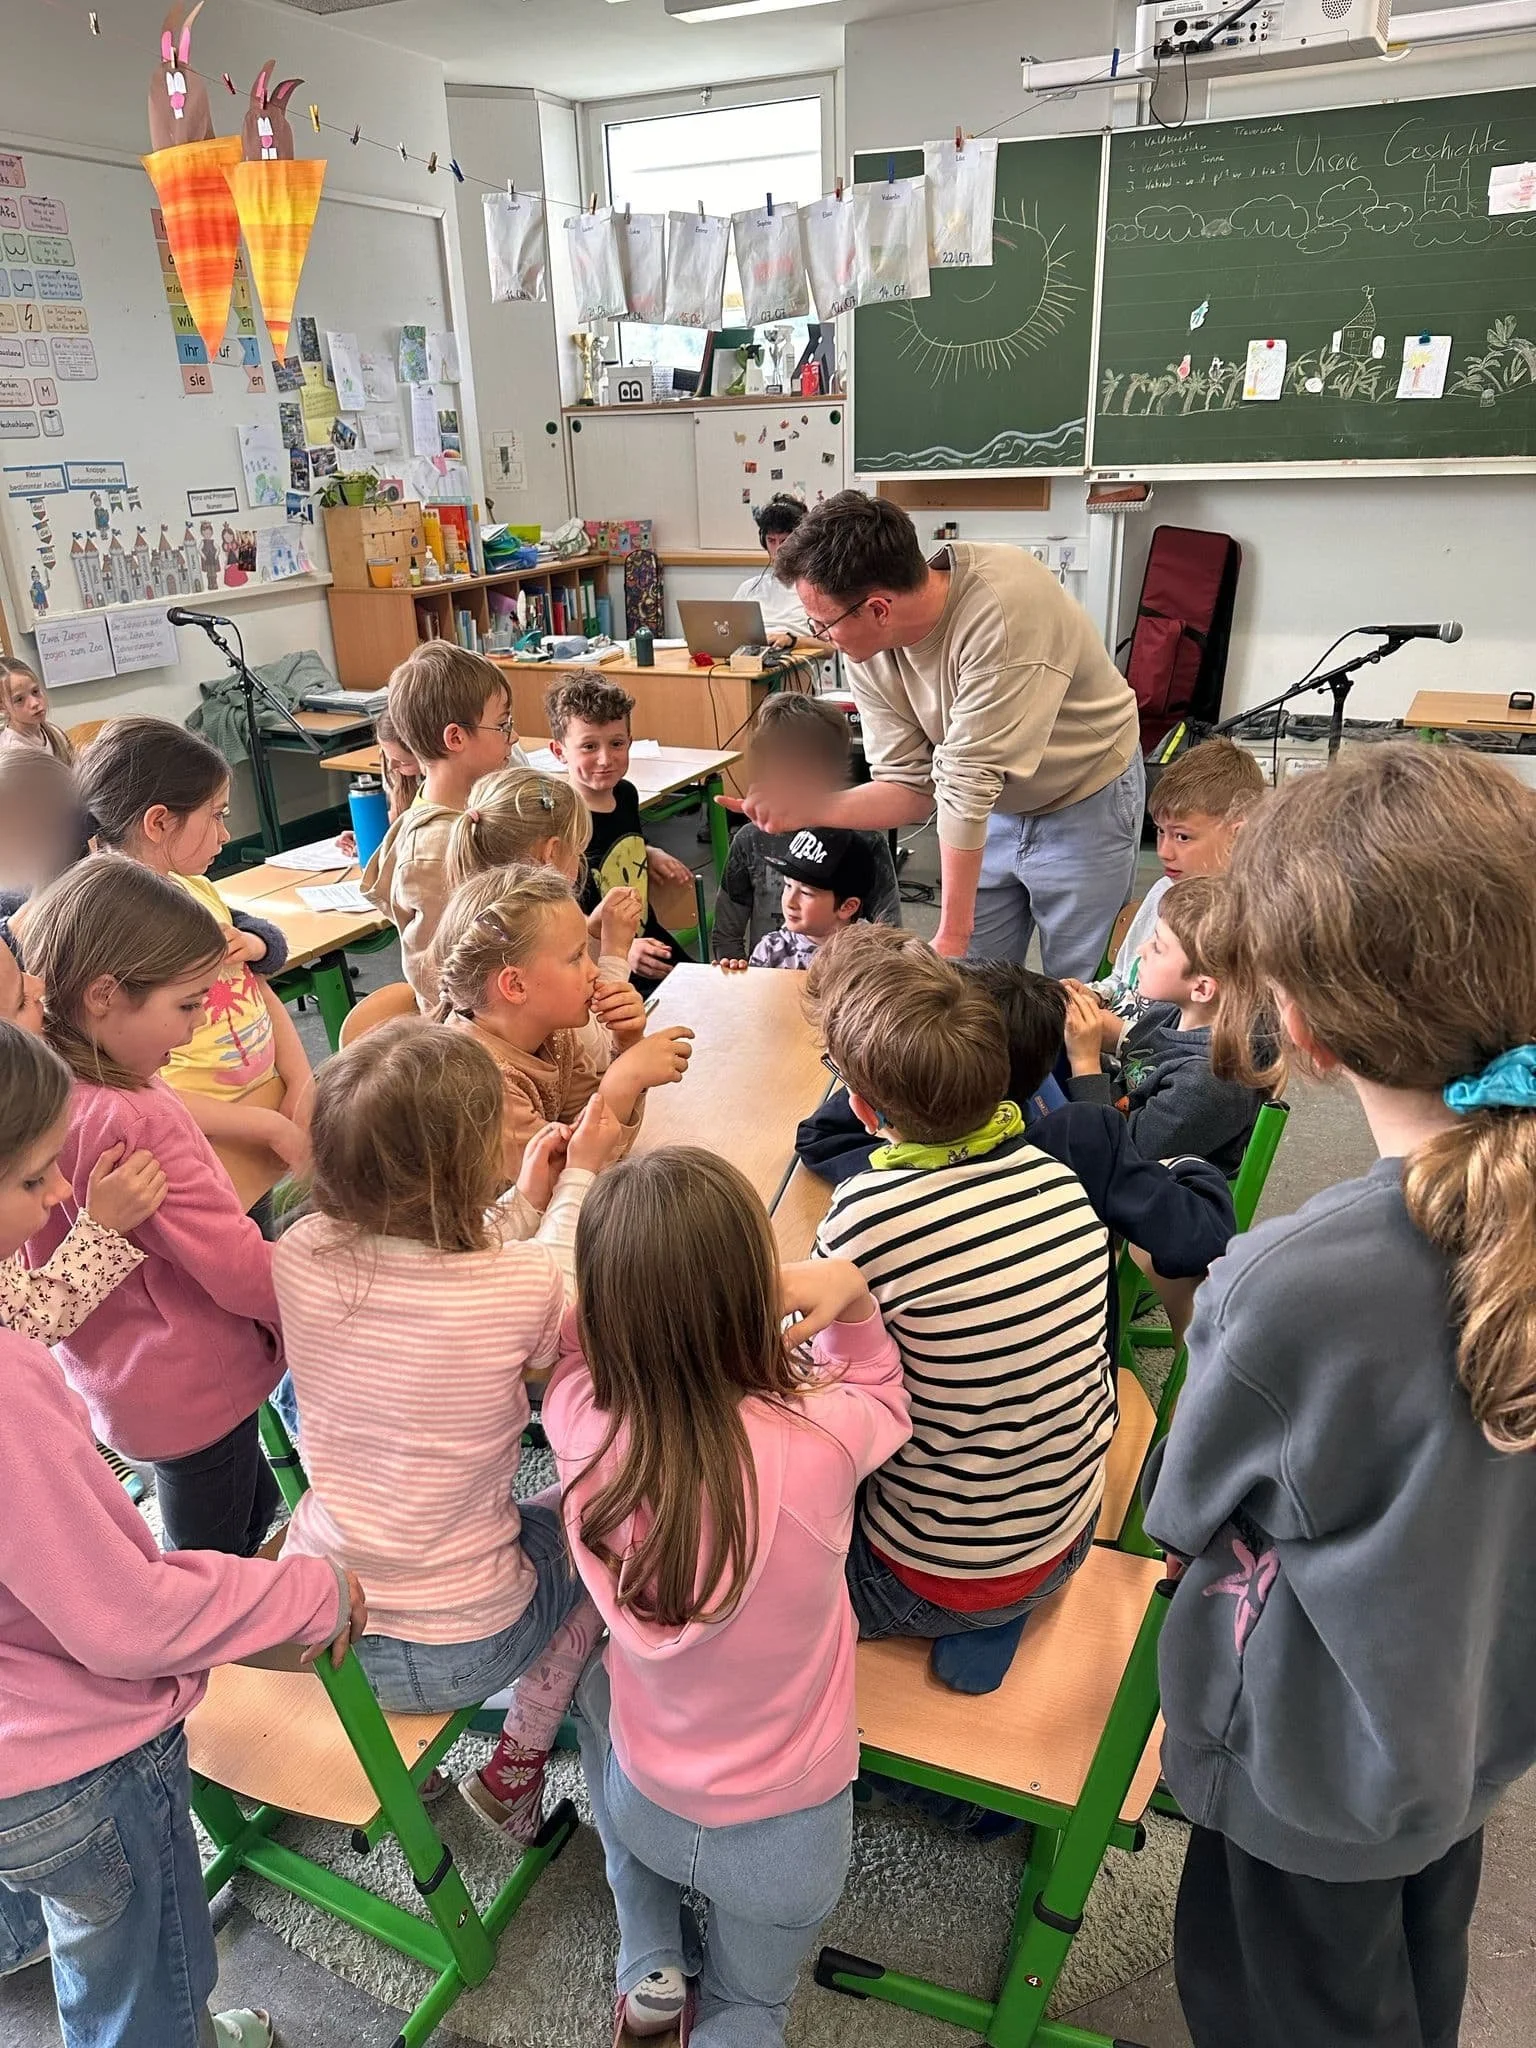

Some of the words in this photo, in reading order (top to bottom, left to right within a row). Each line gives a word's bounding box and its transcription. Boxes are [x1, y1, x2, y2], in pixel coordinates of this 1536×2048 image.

[1296, 133, 1363, 176] Unsere
[1384, 117, 1509, 167] Geschichte
[1126, 181, 1135, 193] 3
[241, 317, 254, 328] en
[184, 343, 199, 358] ihr
[189, 373, 206, 386] sie
[251, 375, 264, 386] en
[41, 386, 51, 397] M
[40, 632, 60, 645] Zwei
[62, 630, 88, 643] Ziegen
[44, 650, 67, 662] zogen
[70, 647, 86, 656] zum
[88, 642, 104, 653] Zoo
[1028, 1977, 1039, 1987] 4
